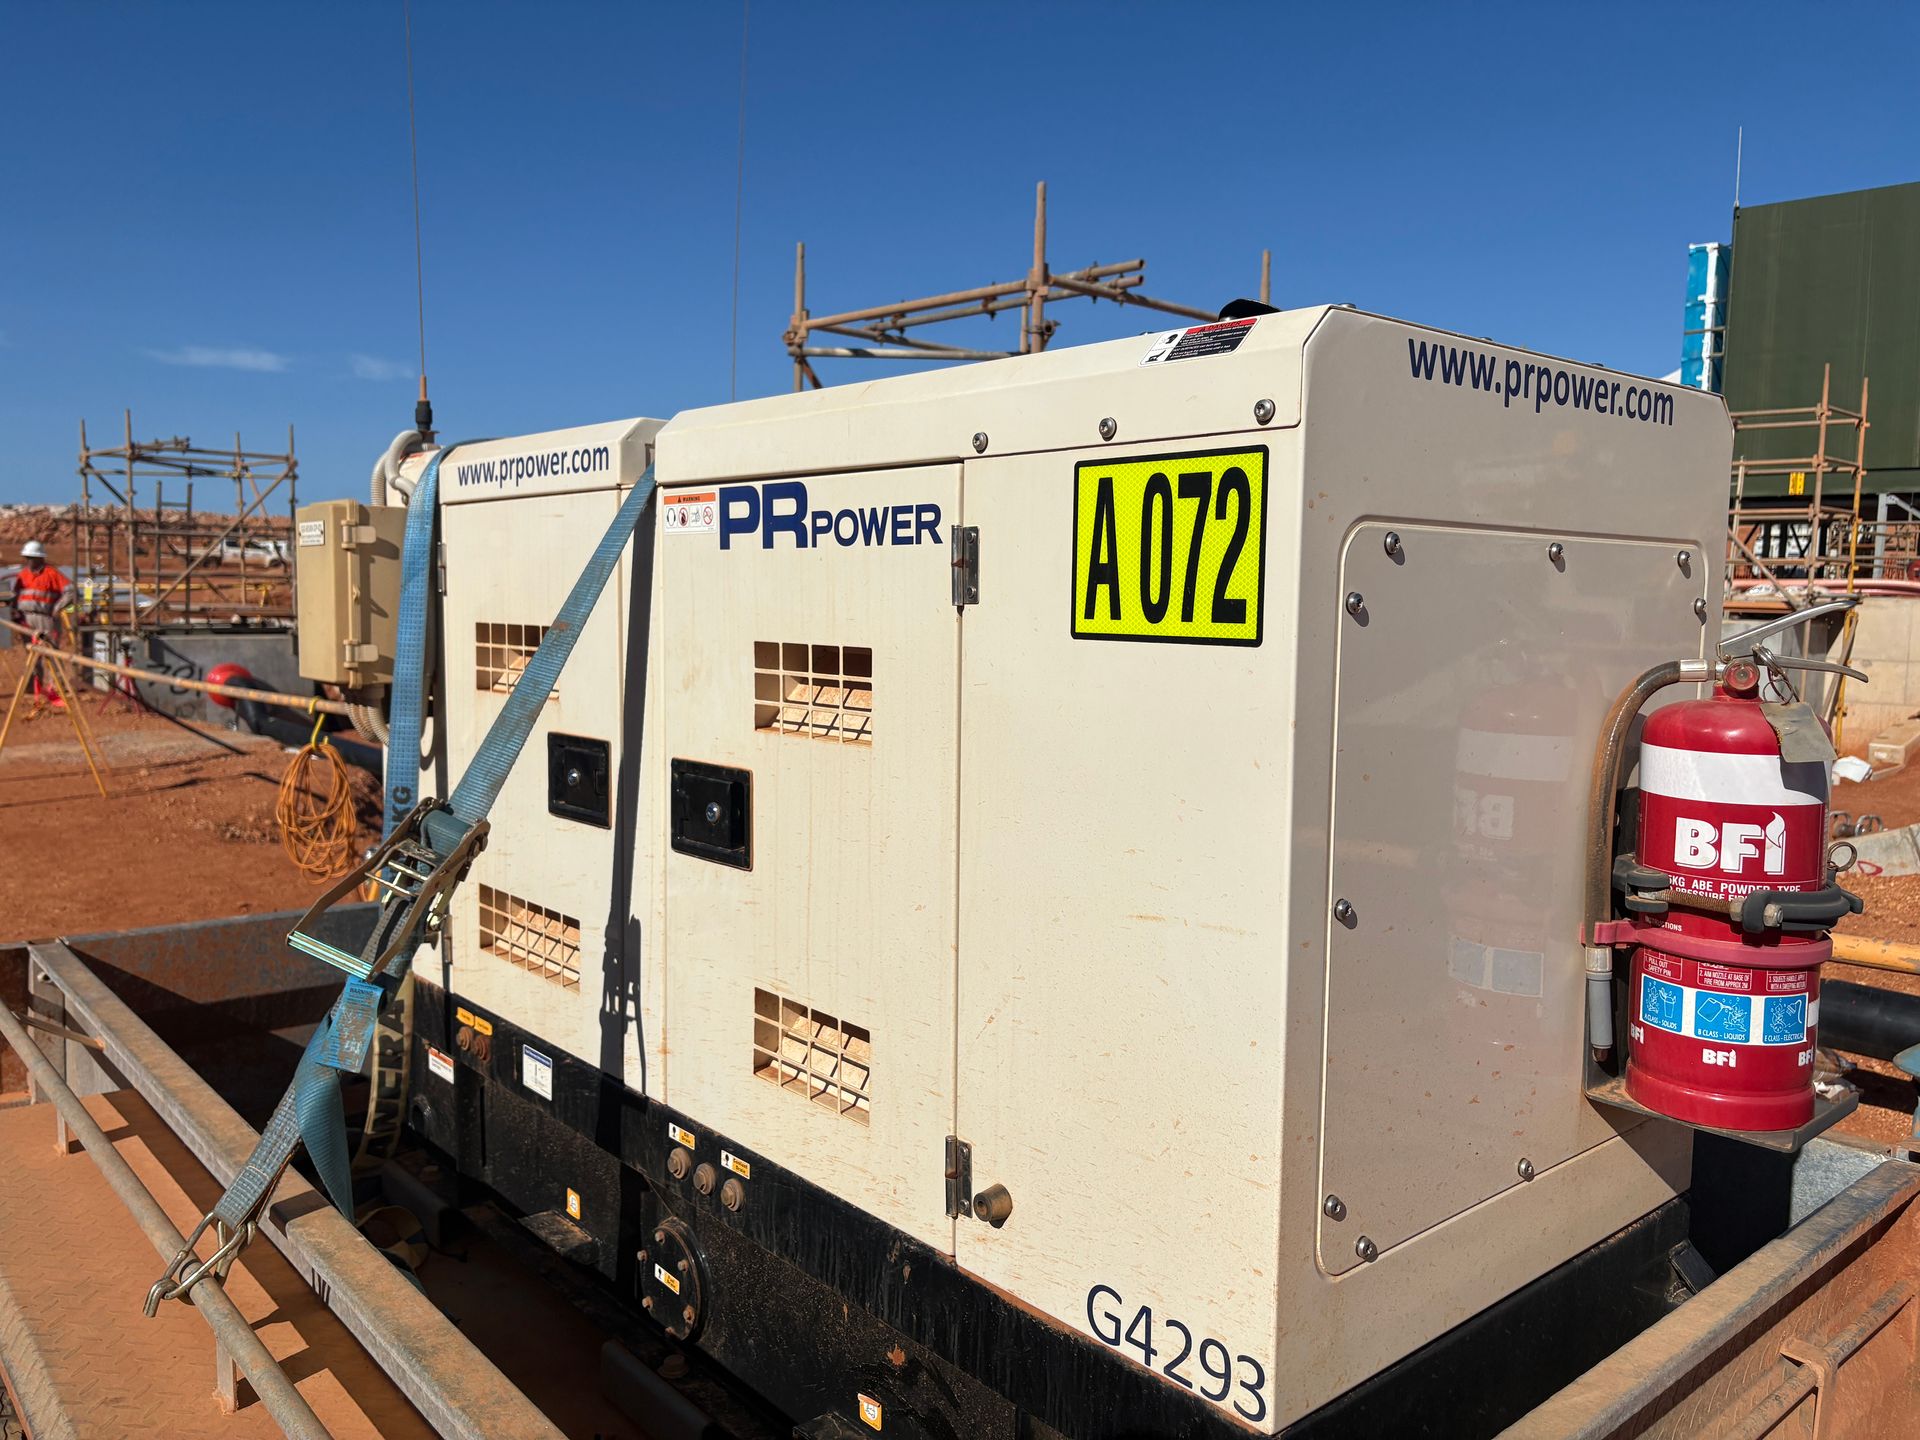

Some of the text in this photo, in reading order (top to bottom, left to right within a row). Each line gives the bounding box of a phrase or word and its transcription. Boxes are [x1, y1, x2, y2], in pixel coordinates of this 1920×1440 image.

[1408, 338, 1674, 426] www.prpower.com
[458, 446, 609, 488] www.prpower.com
[719, 481, 943, 550] PR POWER
[1084, 466, 1251, 624] A 072
[1691, 880, 1713, 892] ABE
[1648, 956, 1658, 966] PULL
[1659, 960, 1668, 968] OUT
[1648, 964, 1662, 974] SAFETY
[1725, 980, 1741, 988] APPROX
[1647, 1014, 1658, 1023] CLASS
[1662, 1020, 1677, 1029] SOLIDS
[1087, 1284, 1266, 1422] G4293
